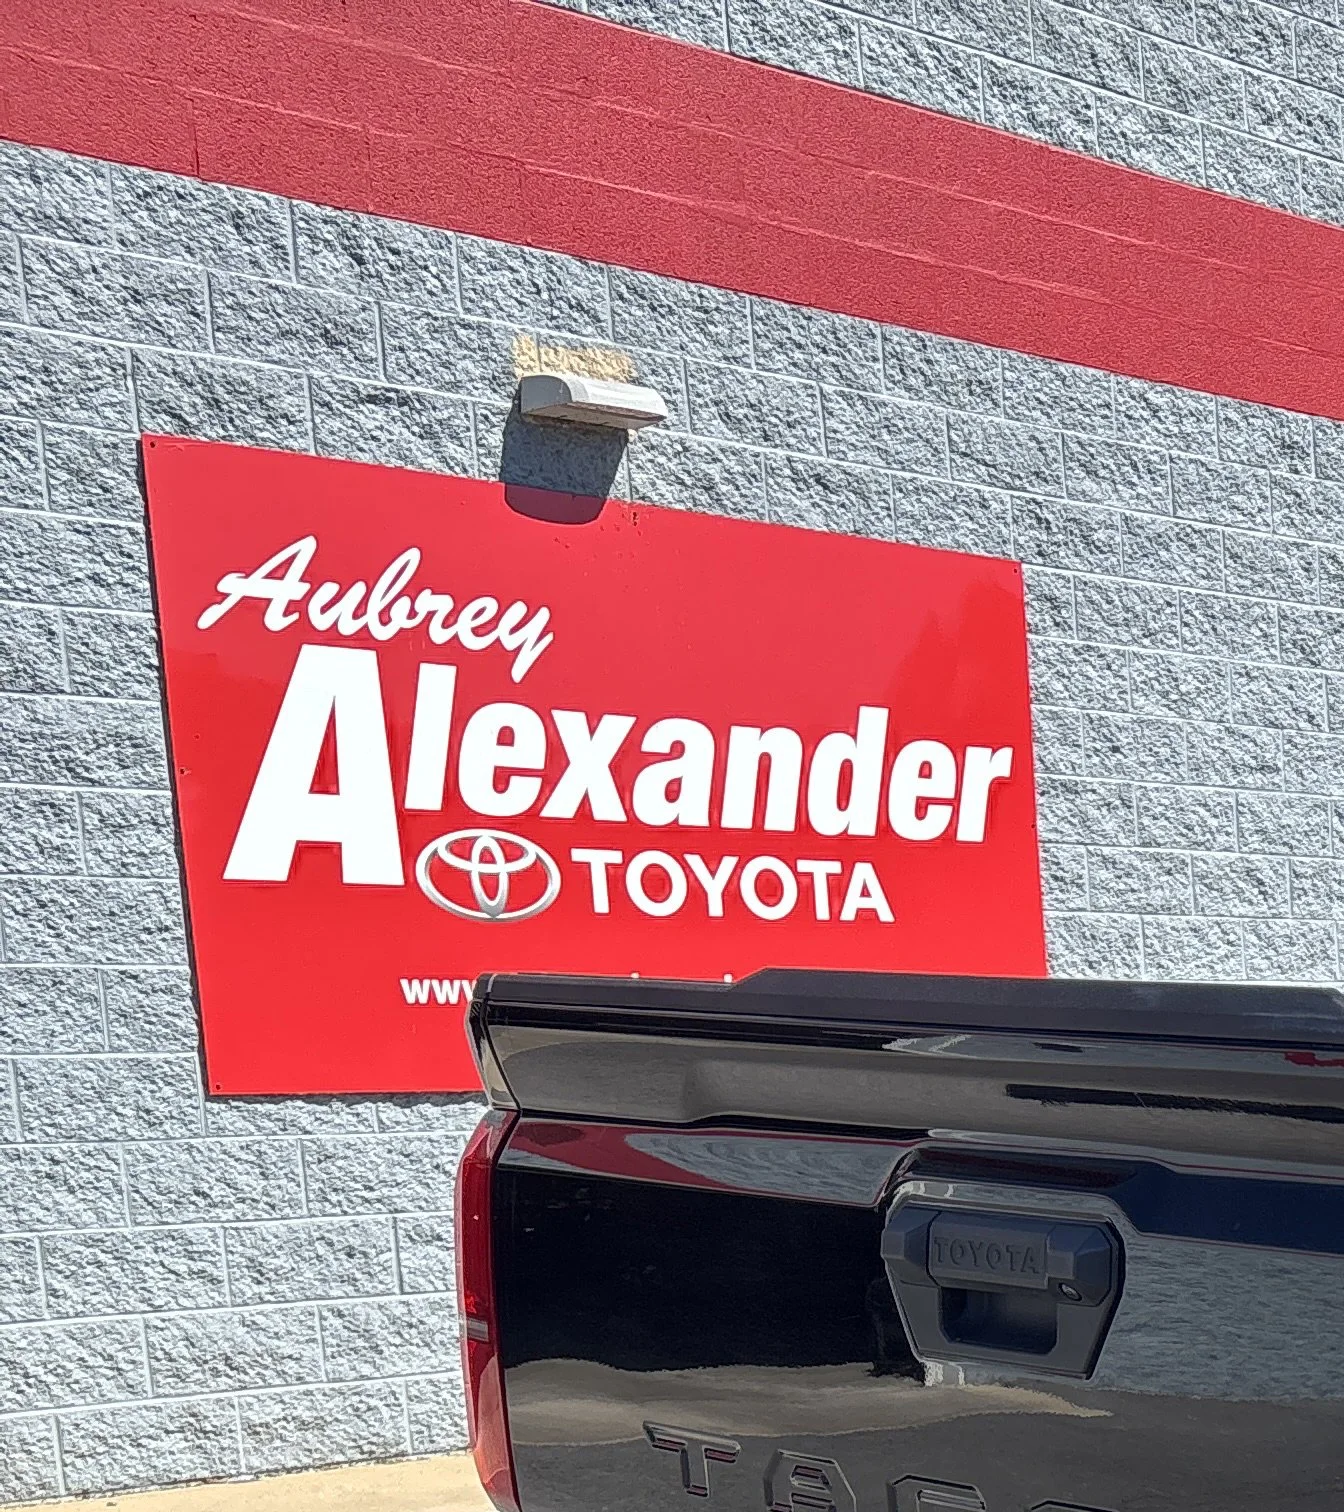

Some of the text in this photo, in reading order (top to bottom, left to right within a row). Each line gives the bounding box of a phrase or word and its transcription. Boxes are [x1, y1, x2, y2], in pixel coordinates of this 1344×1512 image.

[198, 535, 554, 683] Aubrey
[222, 643, 1013, 887] Alexander
[571, 847, 896, 924] TOYOTA
[933, 1236, 1041, 1275] TOYOTA
